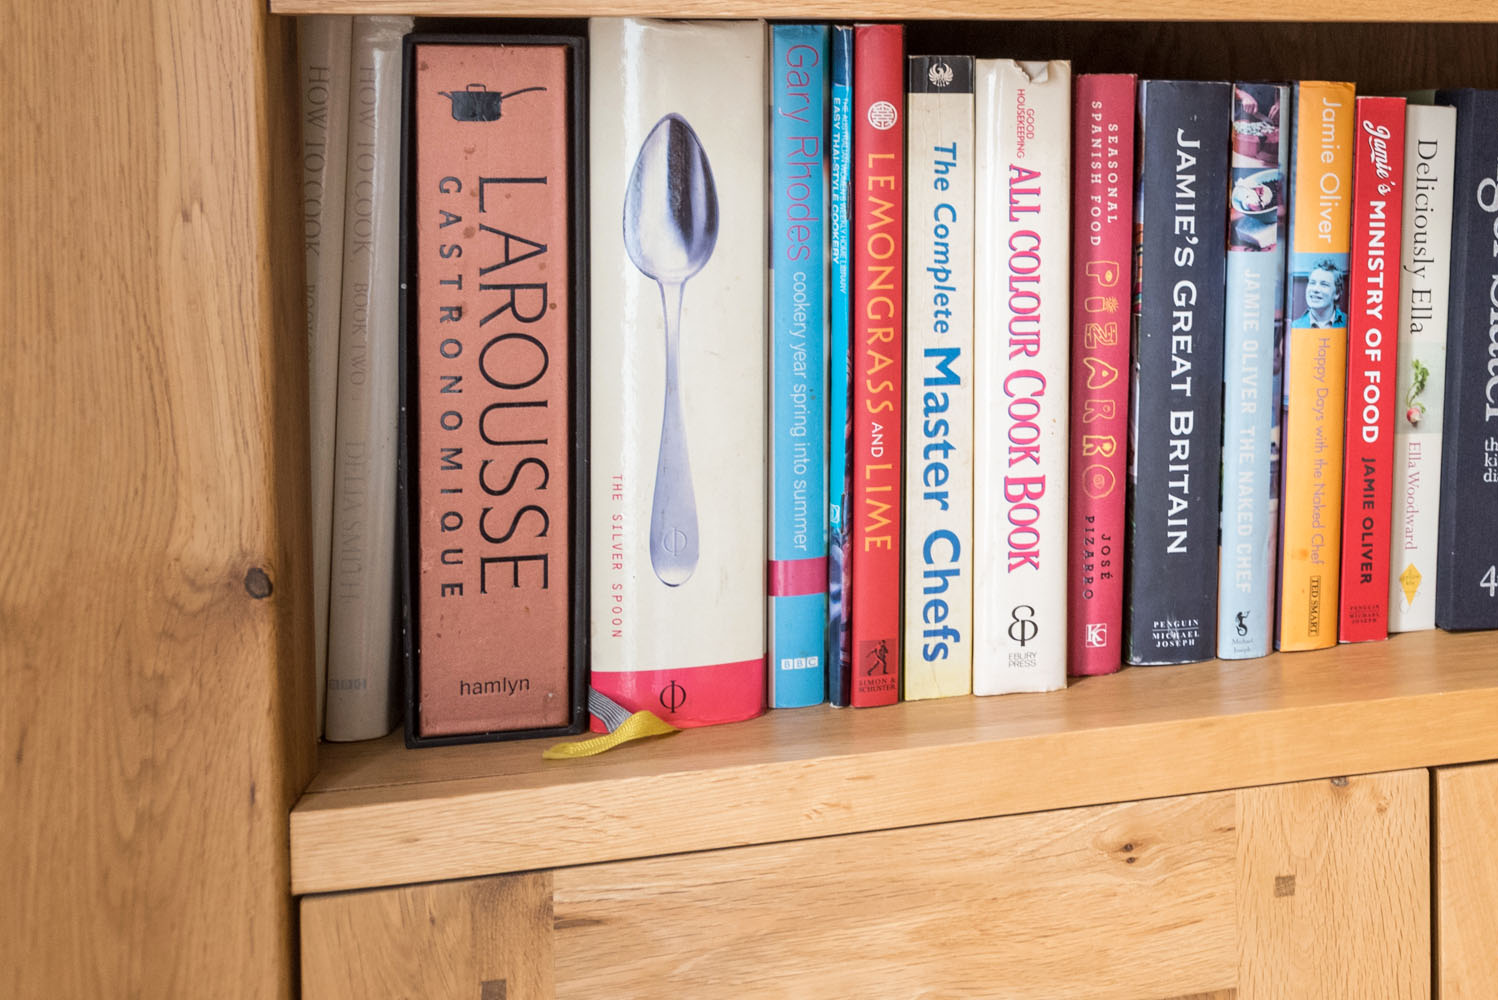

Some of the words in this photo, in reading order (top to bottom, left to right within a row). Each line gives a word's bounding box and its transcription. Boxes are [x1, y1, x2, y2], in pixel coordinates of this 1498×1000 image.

[306, 65, 330, 130] HOW
[778, 44, 819, 123] Gary
[304, 138, 326, 173] TO
[1017, 88, 1026, 158] HOUSEKEEPING
[1027, 108, 1035, 140] GOOD
[1091, 101, 1102, 185] SPANISH
[1320, 97, 1342, 165] Jamie
[832, 133, 840, 200] THAI-STYLE
[934, 141, 957, 192] The
[1108, 122, 1119, 224] SEASONAL
[1362, 119, 1397, 197] Jamie's
[304, 179, 324, 257] COOK
[787, 134, 819, 262] Rhodes
[1008, 163, 1042, 223] ALL
[1090, 194, 1101, 247] FOOD
[1172, 128, 1201, 268] JAMIE'S
[1318, 171, 1342, 243] Oliver
[1402, 139, 1439, 281] Deliciously
[865, 152, 895, 414] LEMONGRASS
[927, 202, 957, 334] Complete
[1008, 228, 1042, 360] COLOUR
[1362, 200, 1387, 321] MINISTRY
[791, 271, 807, 338] cookery
[1171, 279, 1198, 397] GREAT
[1409, 287, 1433, 335] Ella
[791, 341, 807, 379] year
[1364, 327, 1382, 365] OF
[438, 175, 464, 598] GASTRONOMIQUE
[478, 175, 550, 595] LAROUSSE
[791, 383, 807, 439] spring
[1003, 369, 1047, 469] COOK
[1362, 370, 1381, 444] FOOD
[794, 442, 807, 474] into
[871, 422, 884, 458] AND
[922, 346, 961, 511] Master
[1407, 441, 1422, 475] Ella
[612, 474, 622, 501] THE
[794, 478, 807, 552] summer
[864, 464, 892, 552] LIME
[1167, 409, 1194, 554] BRITAIN
[1361, 457, 1376, 510] JAMIE
[1404, 476, 1422, 551] Woodward
[612, 514, 622, 571] SILVER
[1003, 474, 1046, 573] BOOK
[1101, 534, 1112, 580] JOSÉ
[1359, 517, 1374, 585] OLIVER
[1083, 516, 1095, 600] PIZARRO
[612, 583, 622, 639] SPOON
[922, 529, 961, 662] Chefs
[1153, 619, 1199, 628] PENGUIN
[1008, 651, 1037, 660] EBURY
[1008, 659, 1037, 668] PRESS
[1152, 629, 1200, 639] MICHAEL
[1156, 638, 1195, 648] JOSEPH
[460, 676, 530, 696] hamlyn
